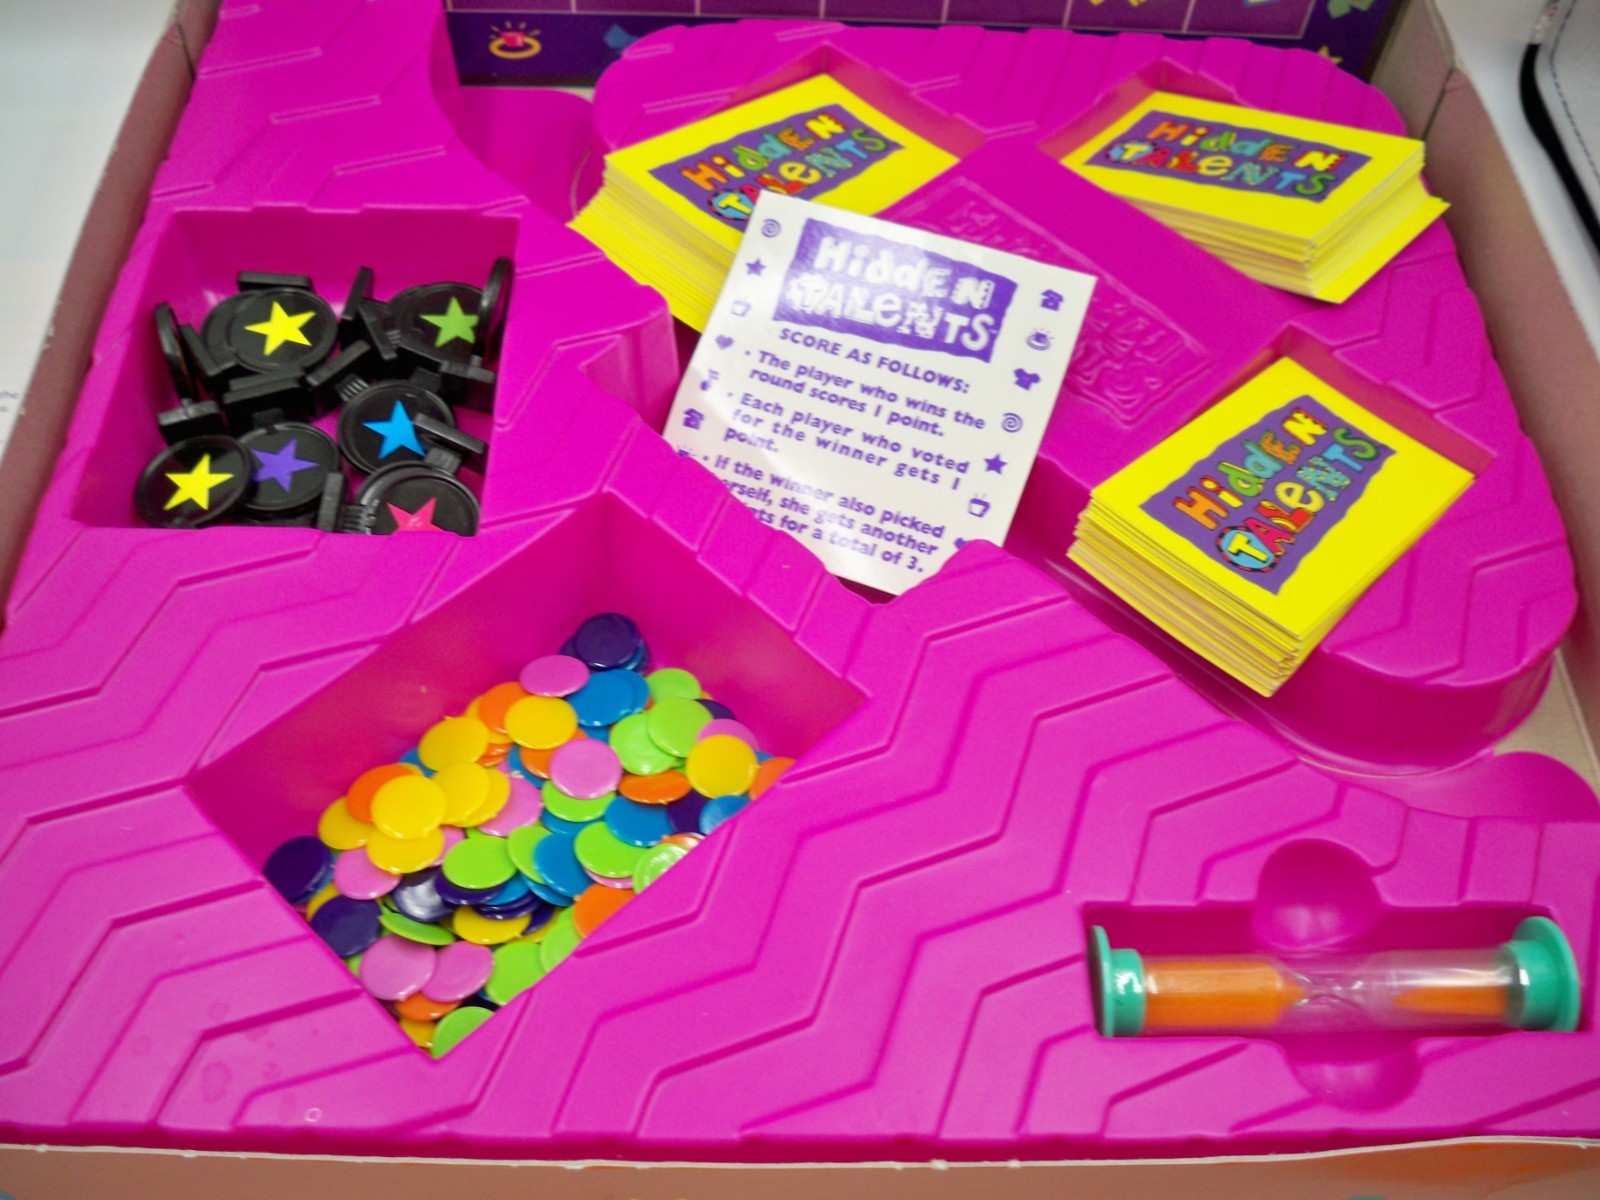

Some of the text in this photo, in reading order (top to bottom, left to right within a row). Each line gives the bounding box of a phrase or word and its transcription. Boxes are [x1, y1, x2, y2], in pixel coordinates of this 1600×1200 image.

[758, 349, 986, 430] The player who wins the
[779, 328, 970, 394] SCORE AS FOLLOWS:
[740, 392, 970, 475] Each player who voted
[749, 368, 807, 394] round
[808, 387, 867, 413] scores
[886, 411, 944, 437] point.
[732, 408, 765, 428] for
[771, 421, 806, 442] the
[815, 436, 888, 467] winner
[893, 462, 941, 484] gets
[714, 454, 946, 539] If the winner also picked
[778, 496, 810, 515] she
[813, 508, 856, 530] gets
[860, 522, 939, 556] another
[779, 514, 809, 534] for
[811, 528, 824, 540] a
[829, 531, 878, 557] total
[881, 549, 904, 565] of
[906, 555, 924, 574] 3.
